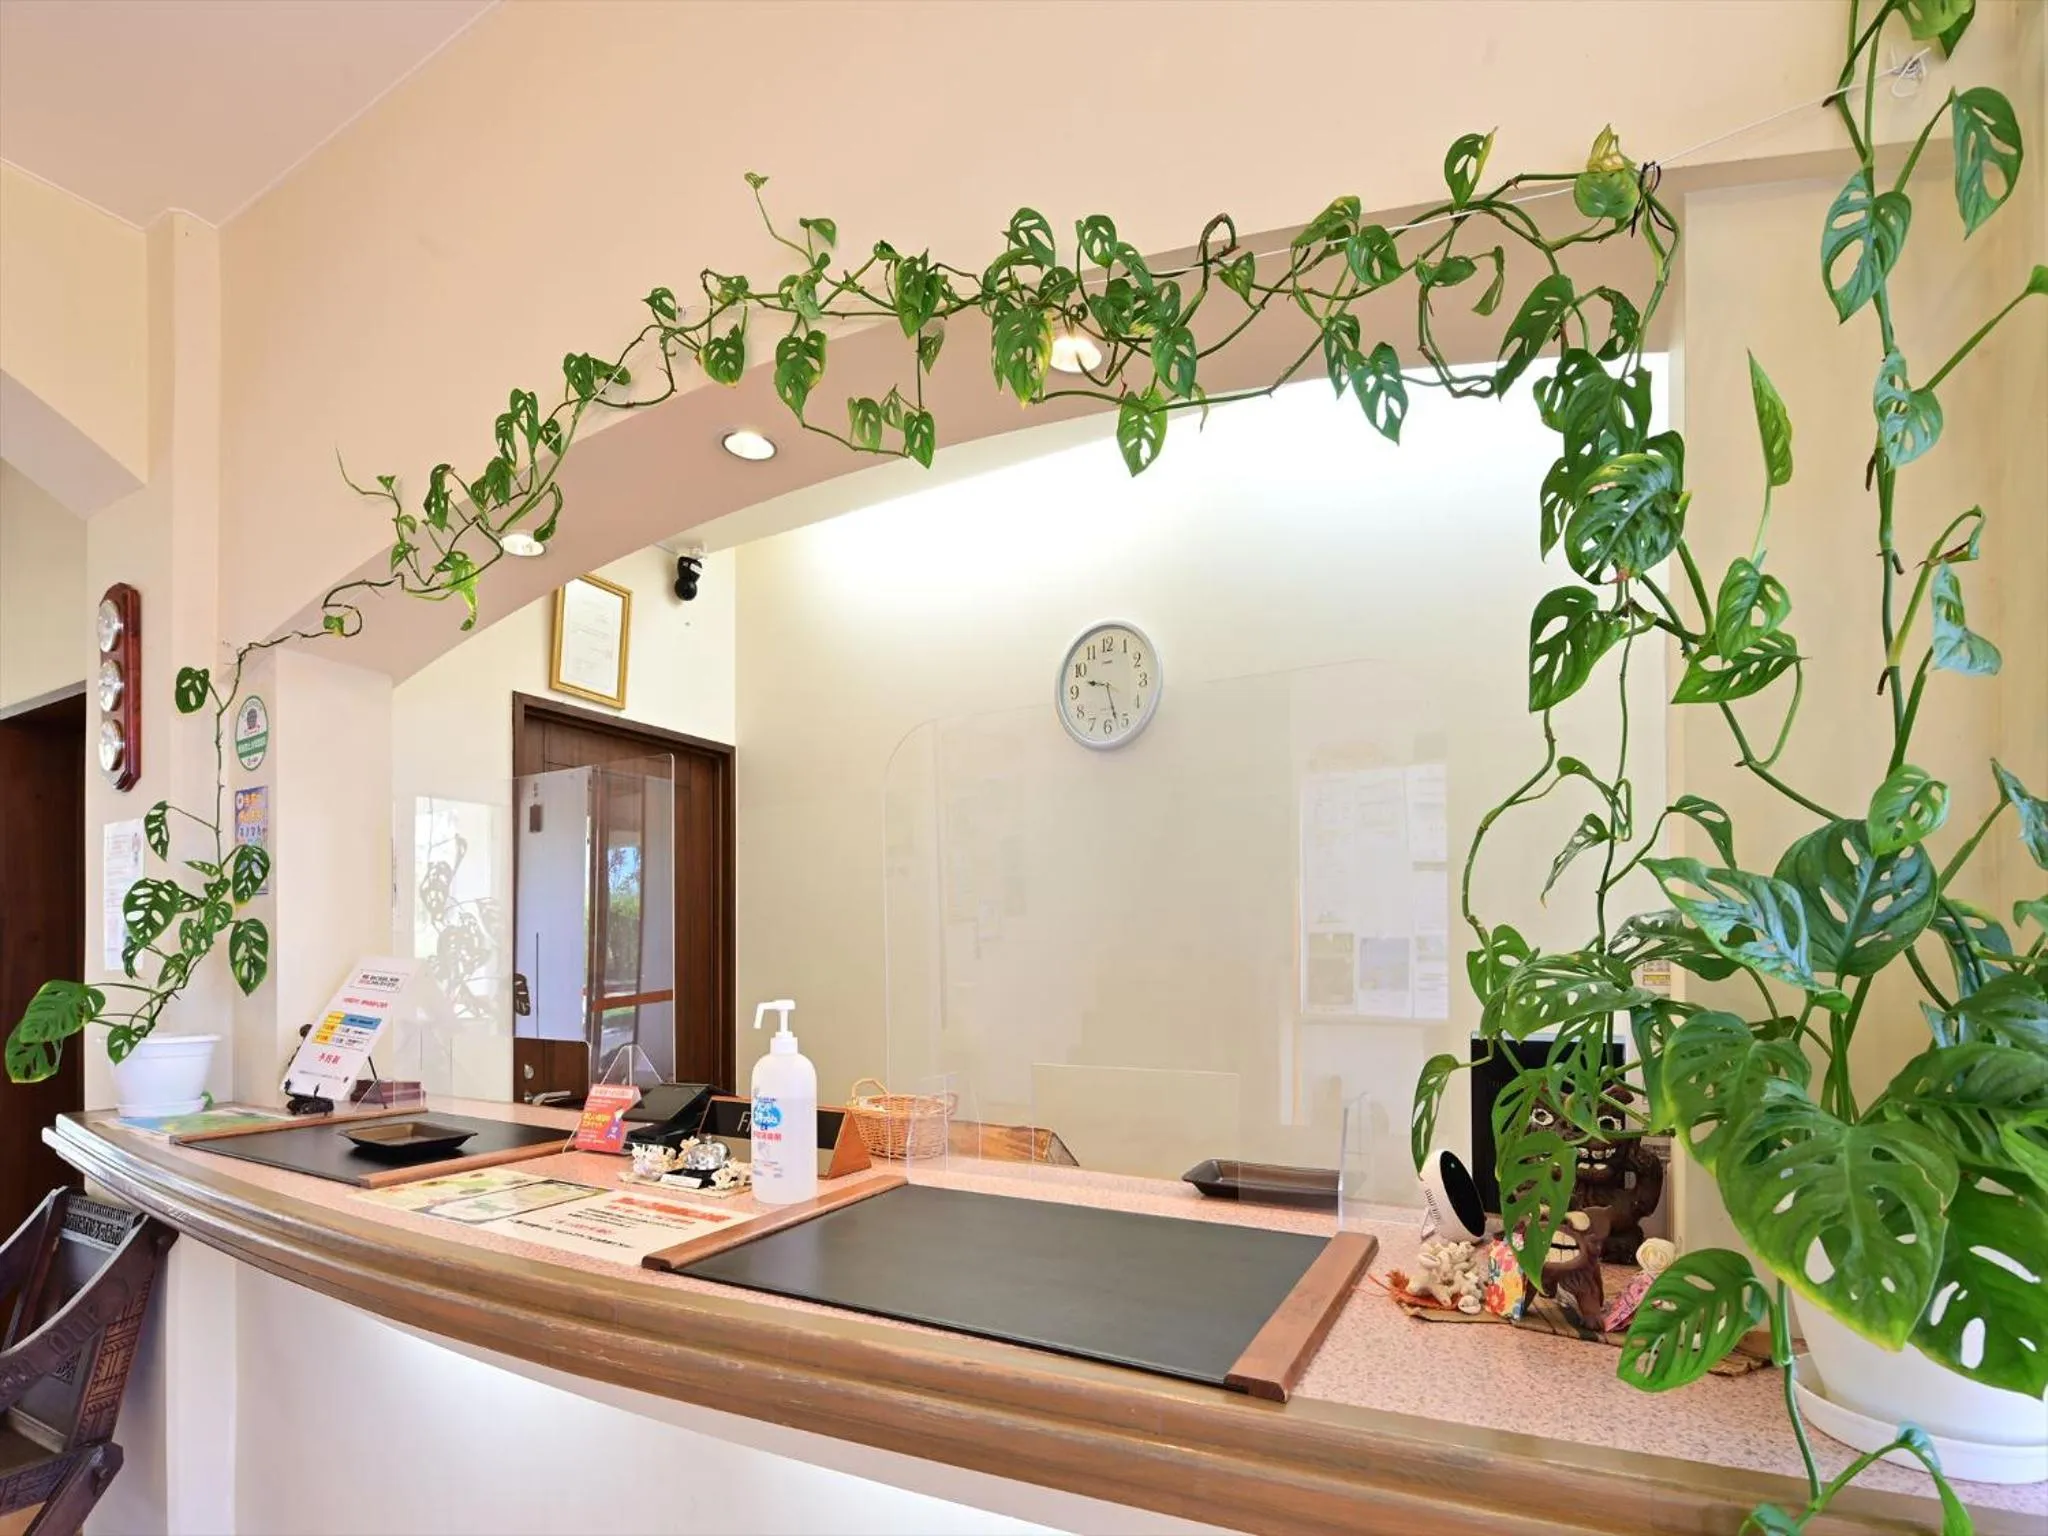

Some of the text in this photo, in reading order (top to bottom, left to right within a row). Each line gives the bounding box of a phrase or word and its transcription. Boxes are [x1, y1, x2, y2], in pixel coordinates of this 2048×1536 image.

[1102, 636, 1114, 653] 12
[1122, 638, 1128, 654] 1
[1087, 645, 1096, 660] 11
[1133, 652, 1141, 667] 2
[1075, 662, 1087, 678] 10
[1138, 673, 1148, 688] 3
[1070, 686, 1079, 700] 9
[1076, 706, 1085, 719] 8
[1087, 718, 1096, 732] 7
[1103, 719, 1112, 734] 6
[1121, 713, 1129, 728] 5
